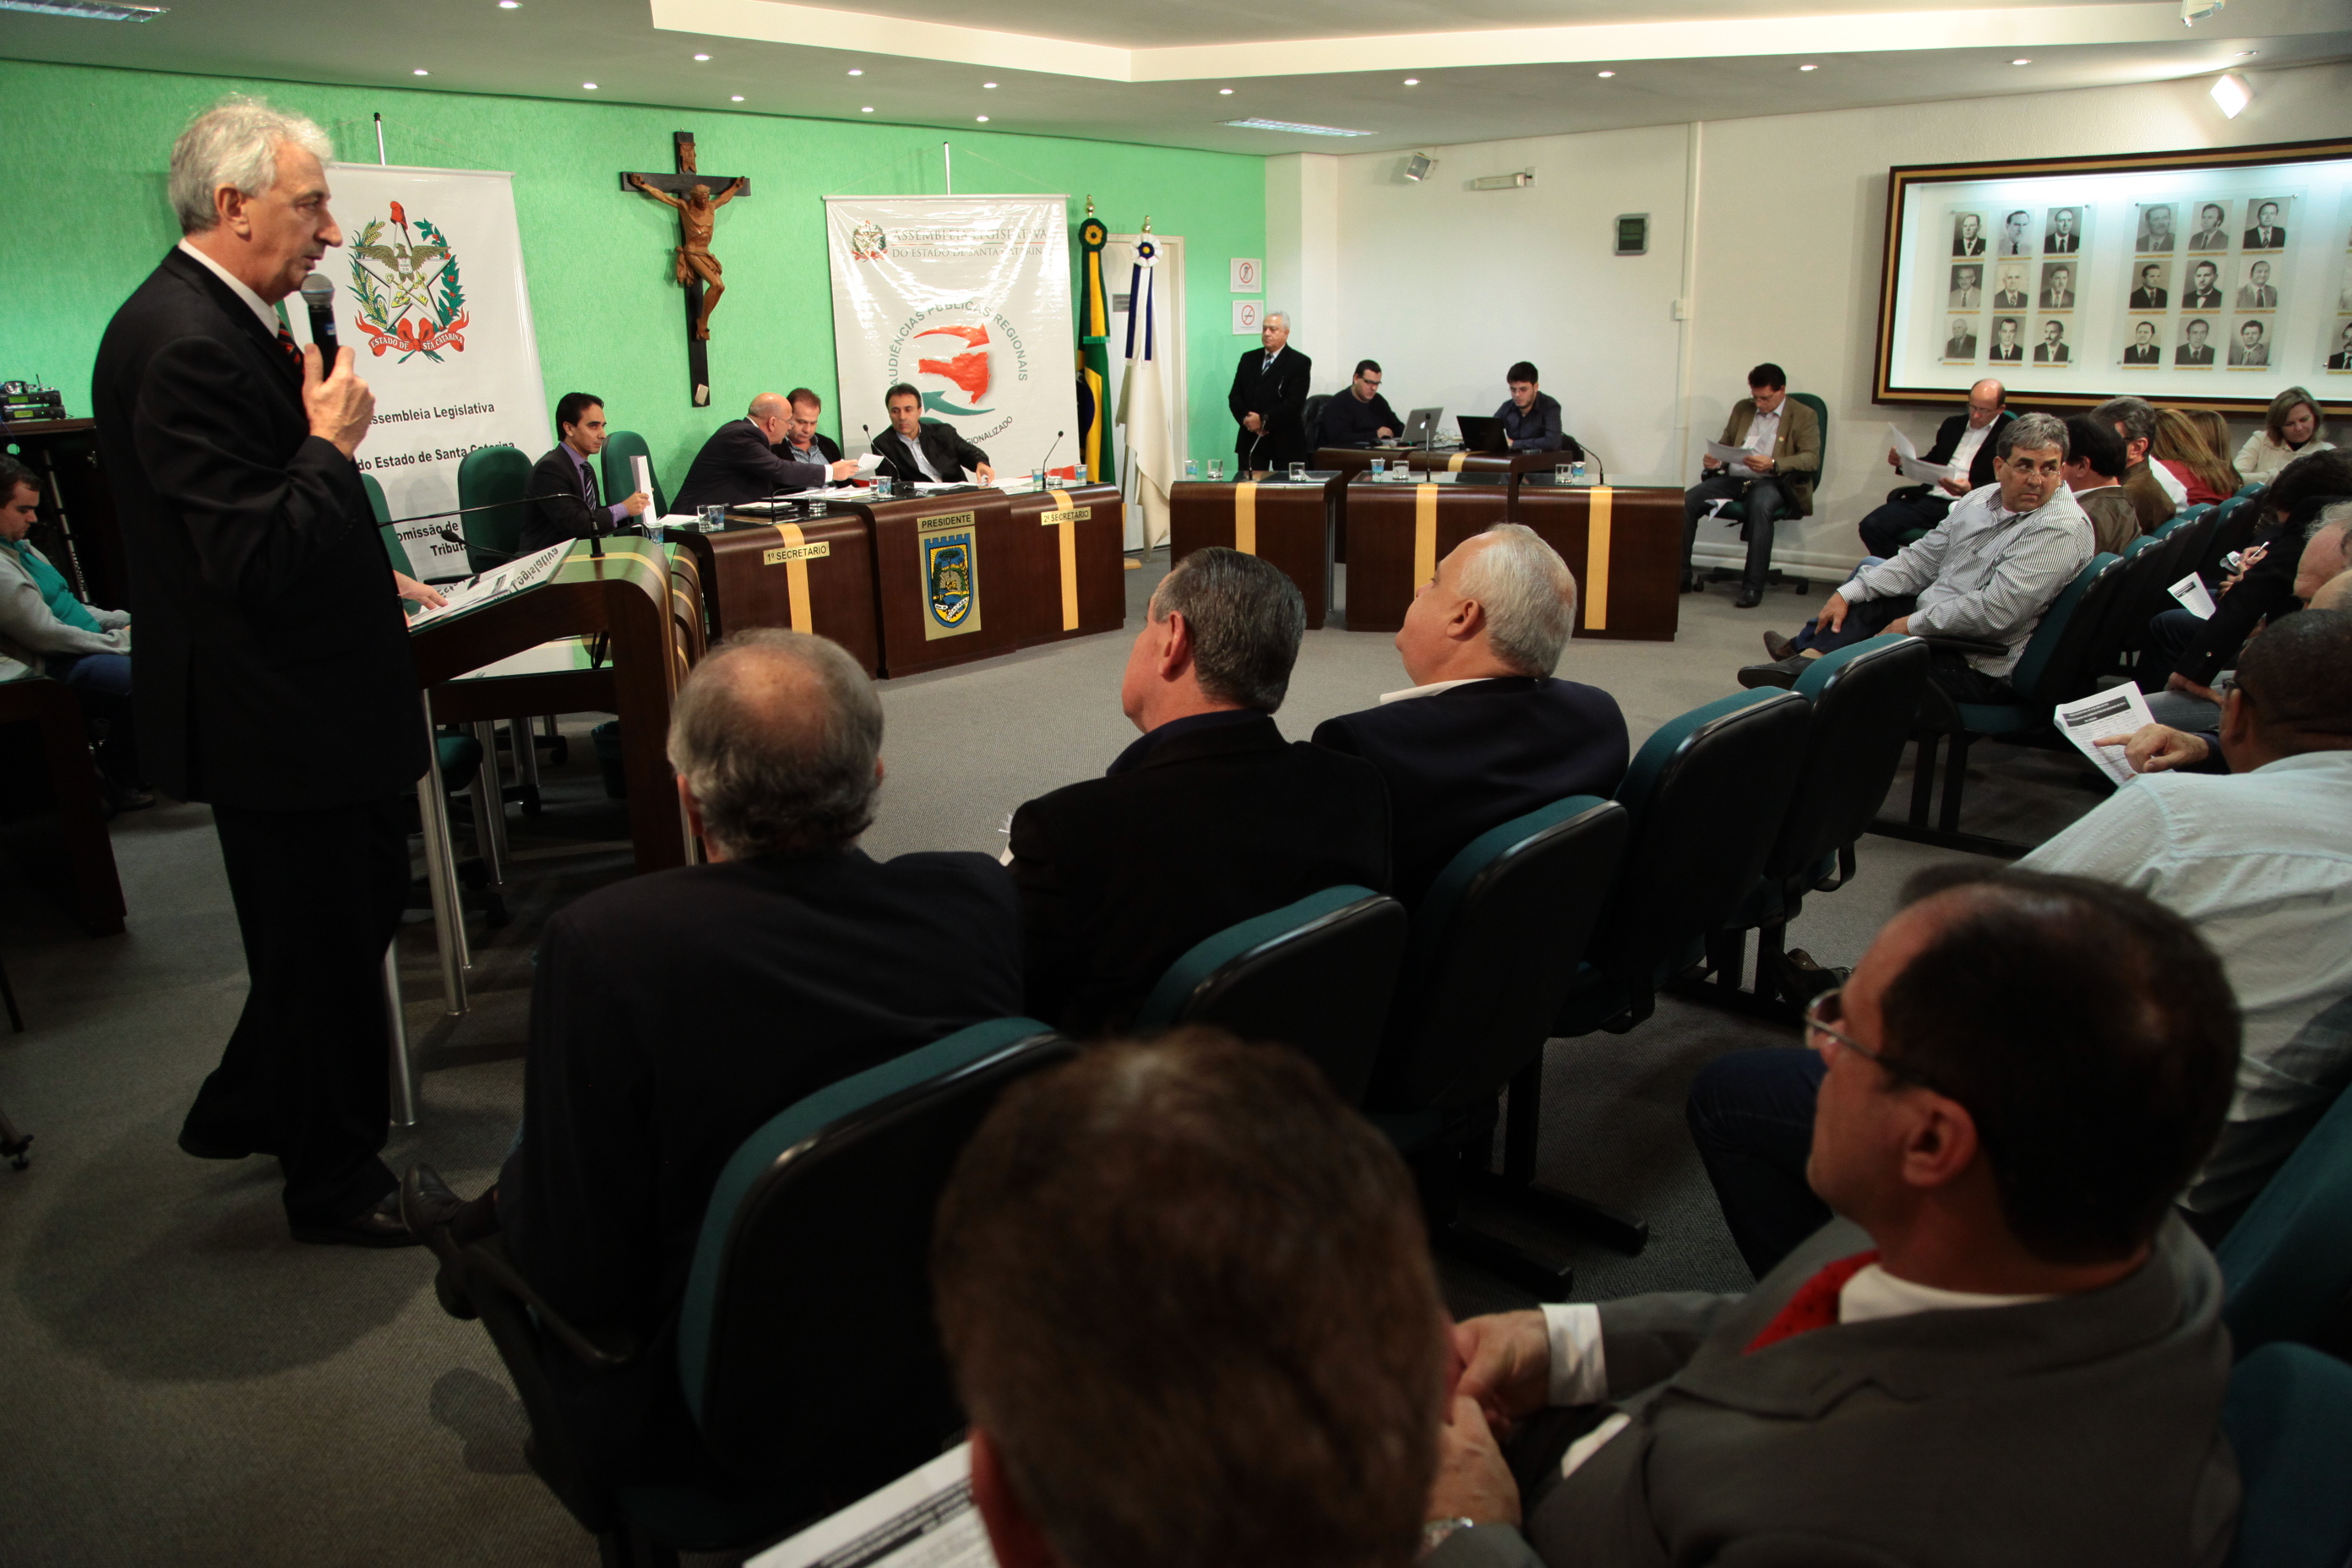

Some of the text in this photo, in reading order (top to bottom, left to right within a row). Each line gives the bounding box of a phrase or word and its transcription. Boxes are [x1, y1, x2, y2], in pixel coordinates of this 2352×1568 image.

[892, 249, 908, 258] DO
[912, 248, 950, 258] ESTADO
[953, 248, 966, 257] DE
[969, 248, 999, 256] SANTA
[371, 337, 398, 348] ESTADO
[399, 341, 409, 350] DE
[888, 311, 925, 386] AUDIÊNCIAS
[993, 313, 1028, 381] REGIONAIS
[370, 402, 495, 425] ssembleia Legislativa
[966, 416, 1013, 445] GIONALIZADO
[358, 459, 372, 471] do
[374, 453, 415, 469] Estado
[418, 450, 433, 463] de
[435, 446, 467, 460] Santa
[922, 514, 972, 529] PRESIDENTE
[397, 520, 459, 542] omissão de
[429, 543, 467, 556] Tribut
[776, 545, 827, 560] SECRETÁRIO
